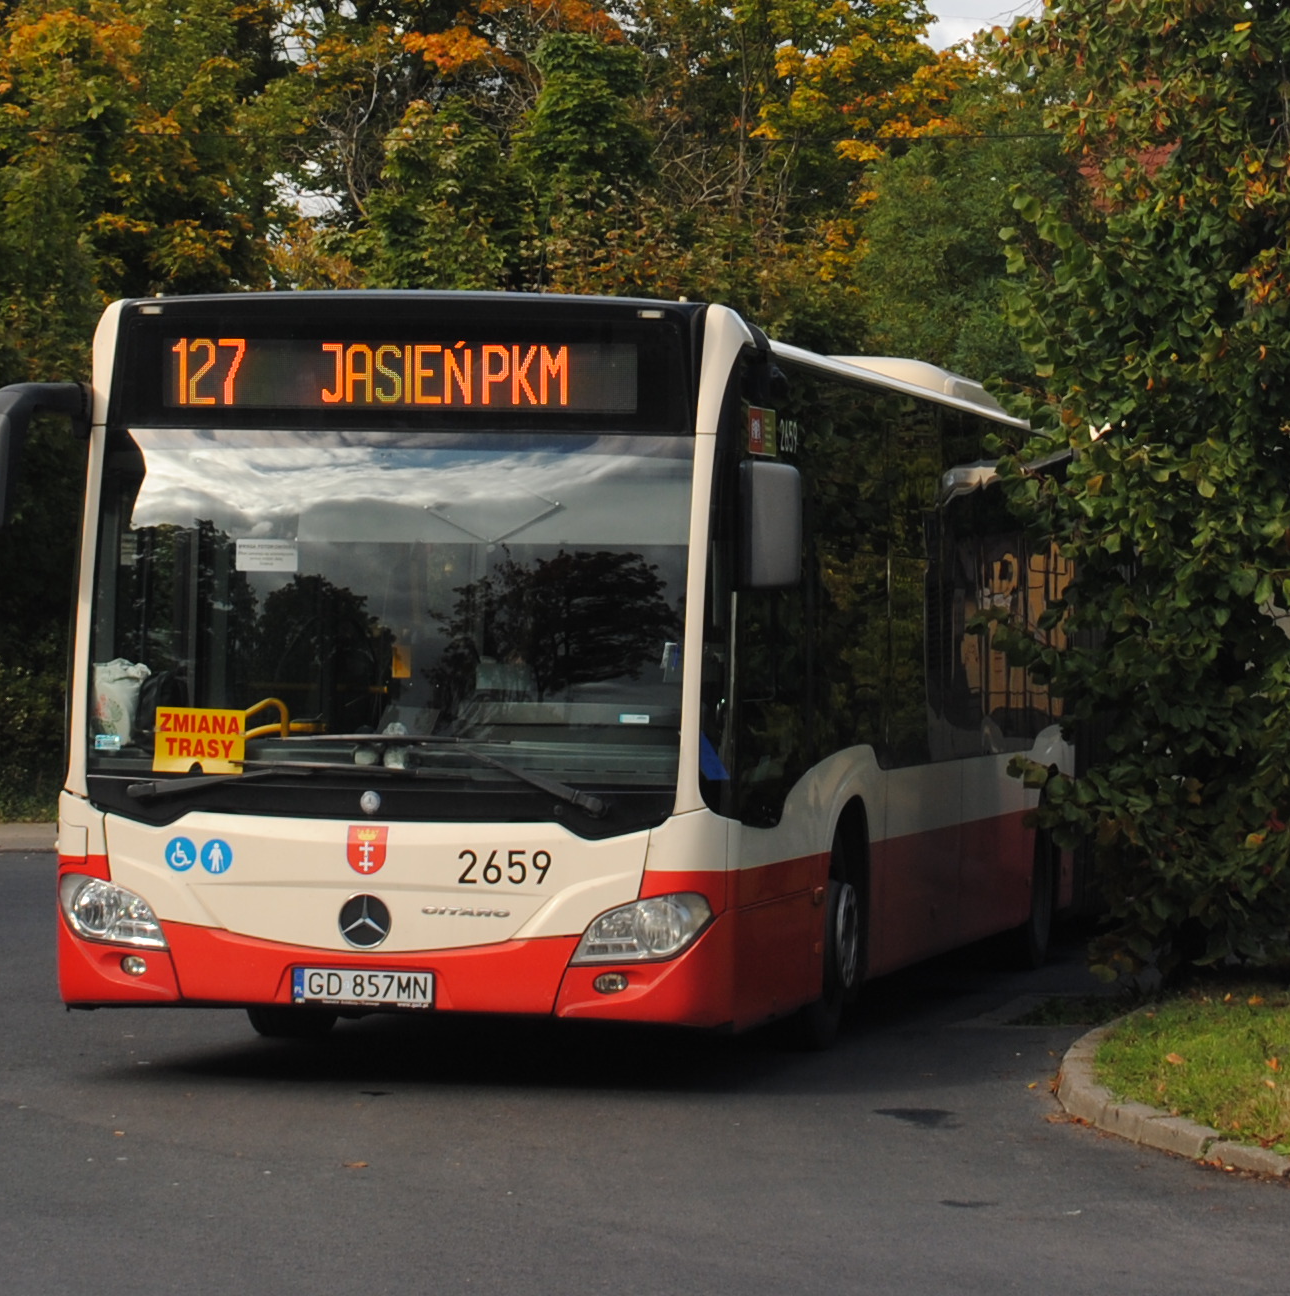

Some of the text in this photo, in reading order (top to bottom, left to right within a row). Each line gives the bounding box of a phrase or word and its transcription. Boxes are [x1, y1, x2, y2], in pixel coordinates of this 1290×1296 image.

[172, 338, 568, 405] 127 JASIEŃ PKM
[779, 418, 798, 454] 2659
[159, 712, 241, 736] ZMIANA
[165, 737, 235, 759] TRASY
[457, 849, 552, 885] 2659
[308, 972, 428, 1000] GD 857MN
